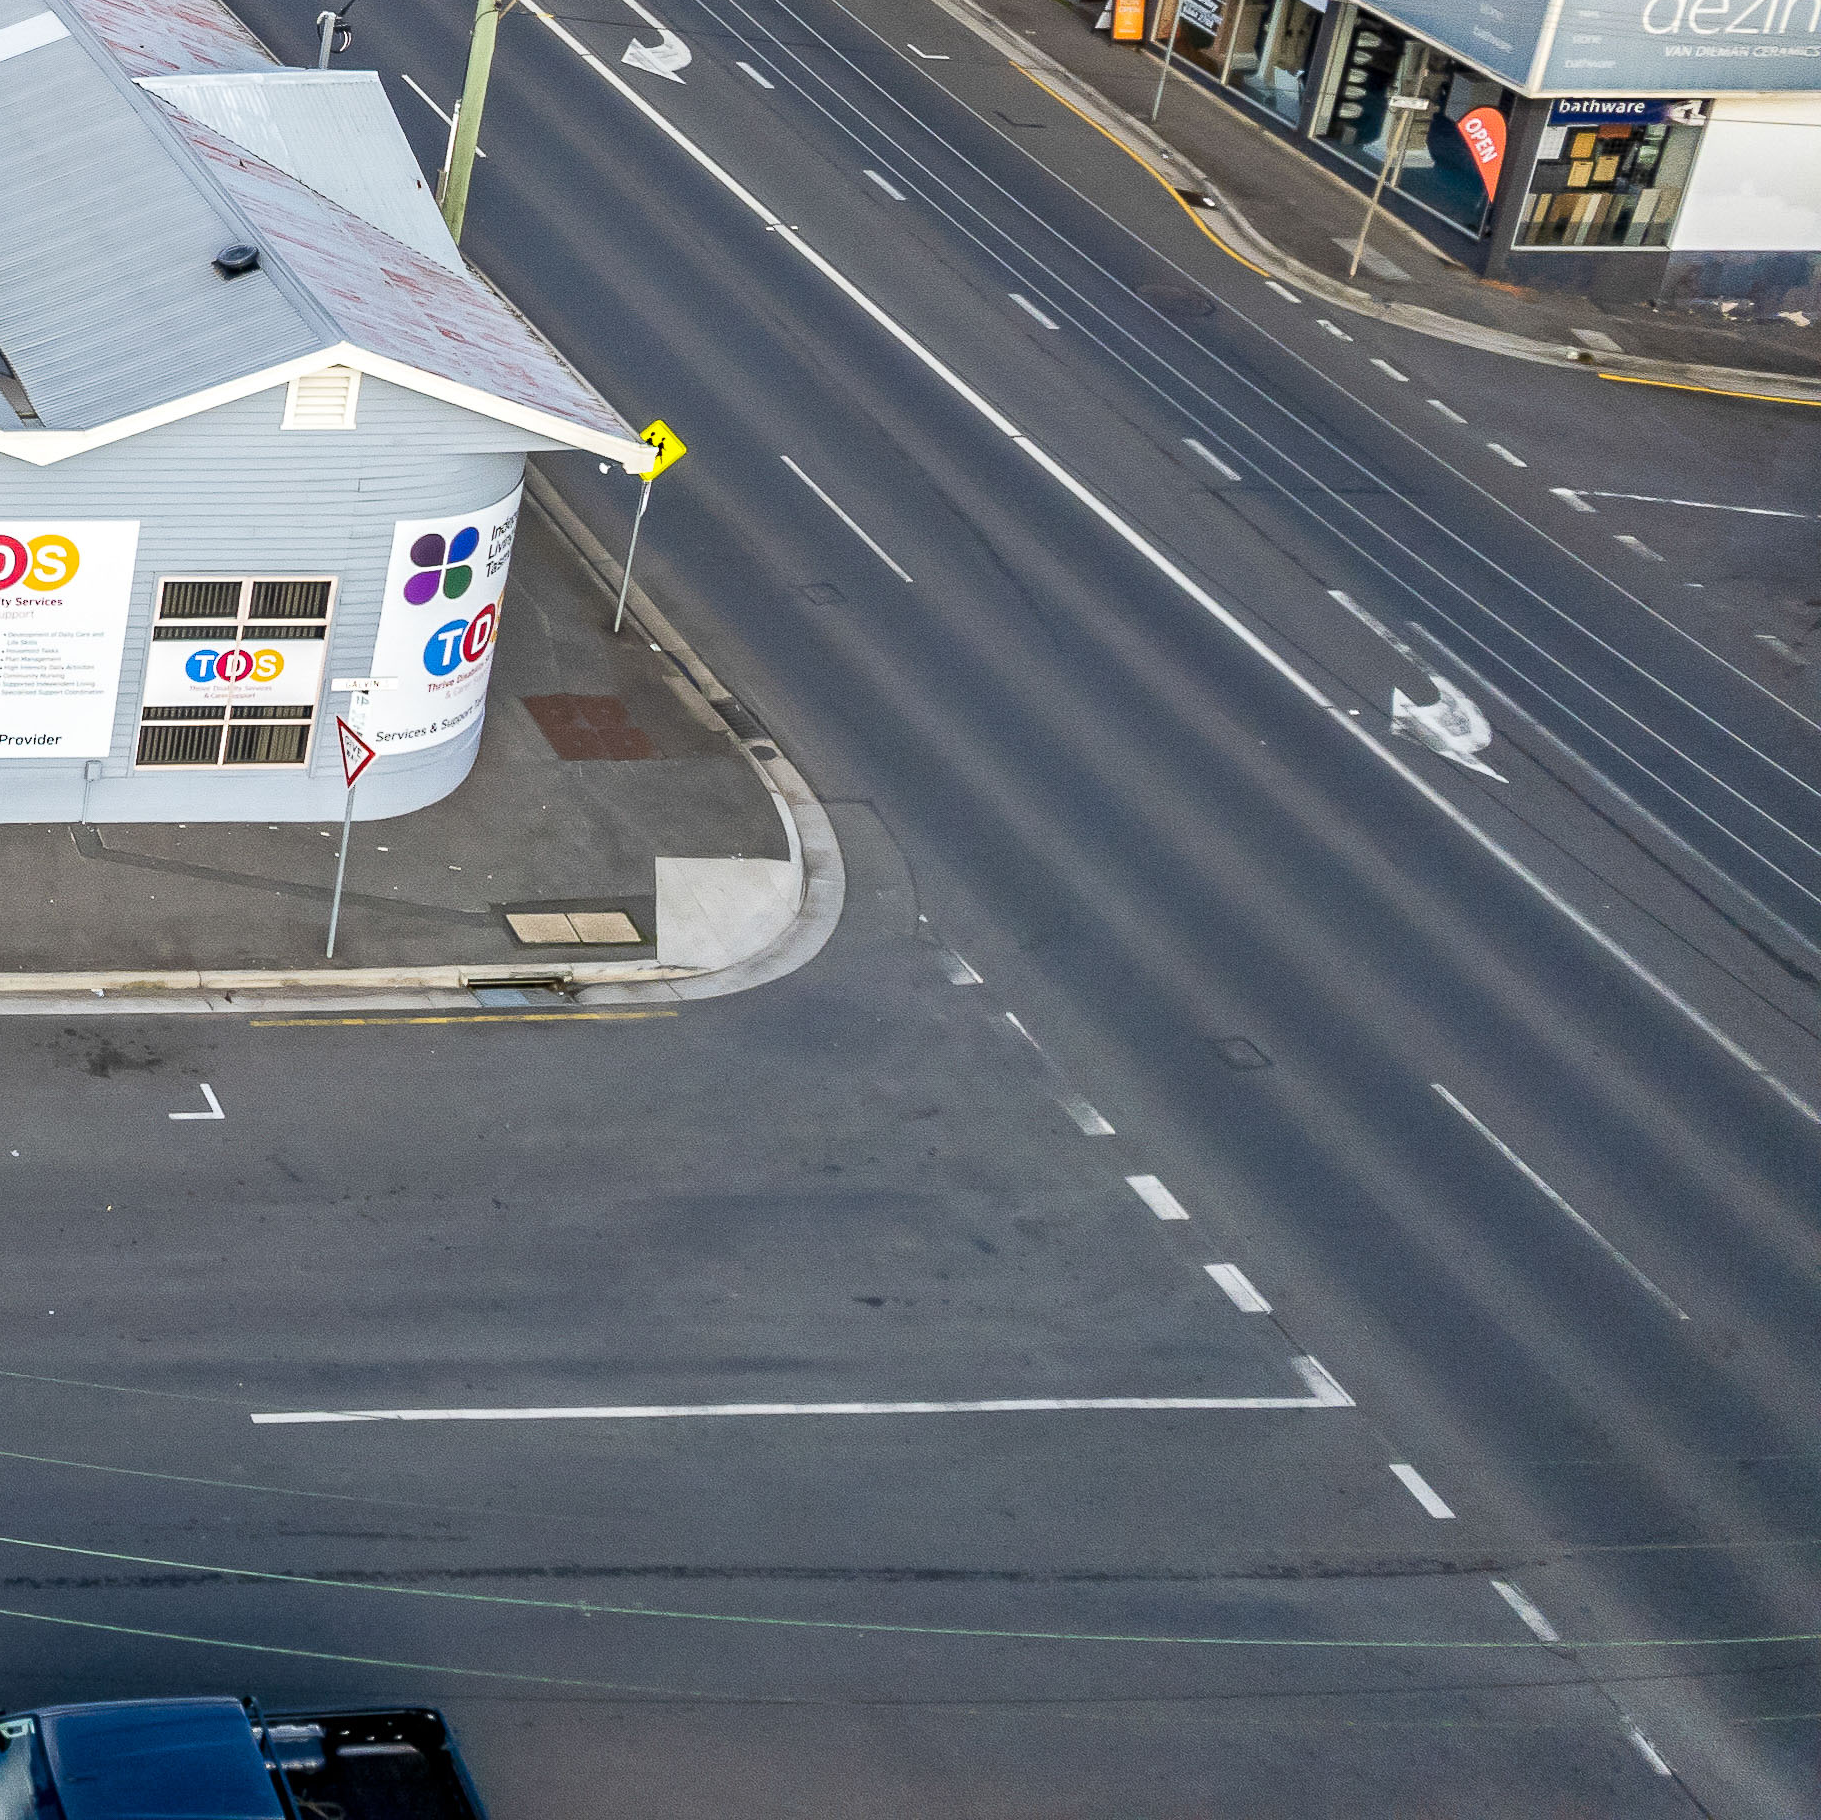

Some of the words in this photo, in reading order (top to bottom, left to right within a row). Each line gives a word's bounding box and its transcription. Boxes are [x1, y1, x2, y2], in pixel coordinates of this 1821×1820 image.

[1664, 45, 1692, 58] VAN
[1752, 45, 1821, 58] CERAMICS
[1558, 98, 1646, 114] bathware
[1464, 117, 1499, 164] OPEN
[14, 596, 64, 607] Services
[194, 653, 278, 678] TDS
[427, 678, 455, 693] Thrive
[375, 726, 428, 744] Services
[429, 723, 439, 735] &
[441, 704, 475, 731] Support
[344, 735, 363, 760] GIVE
